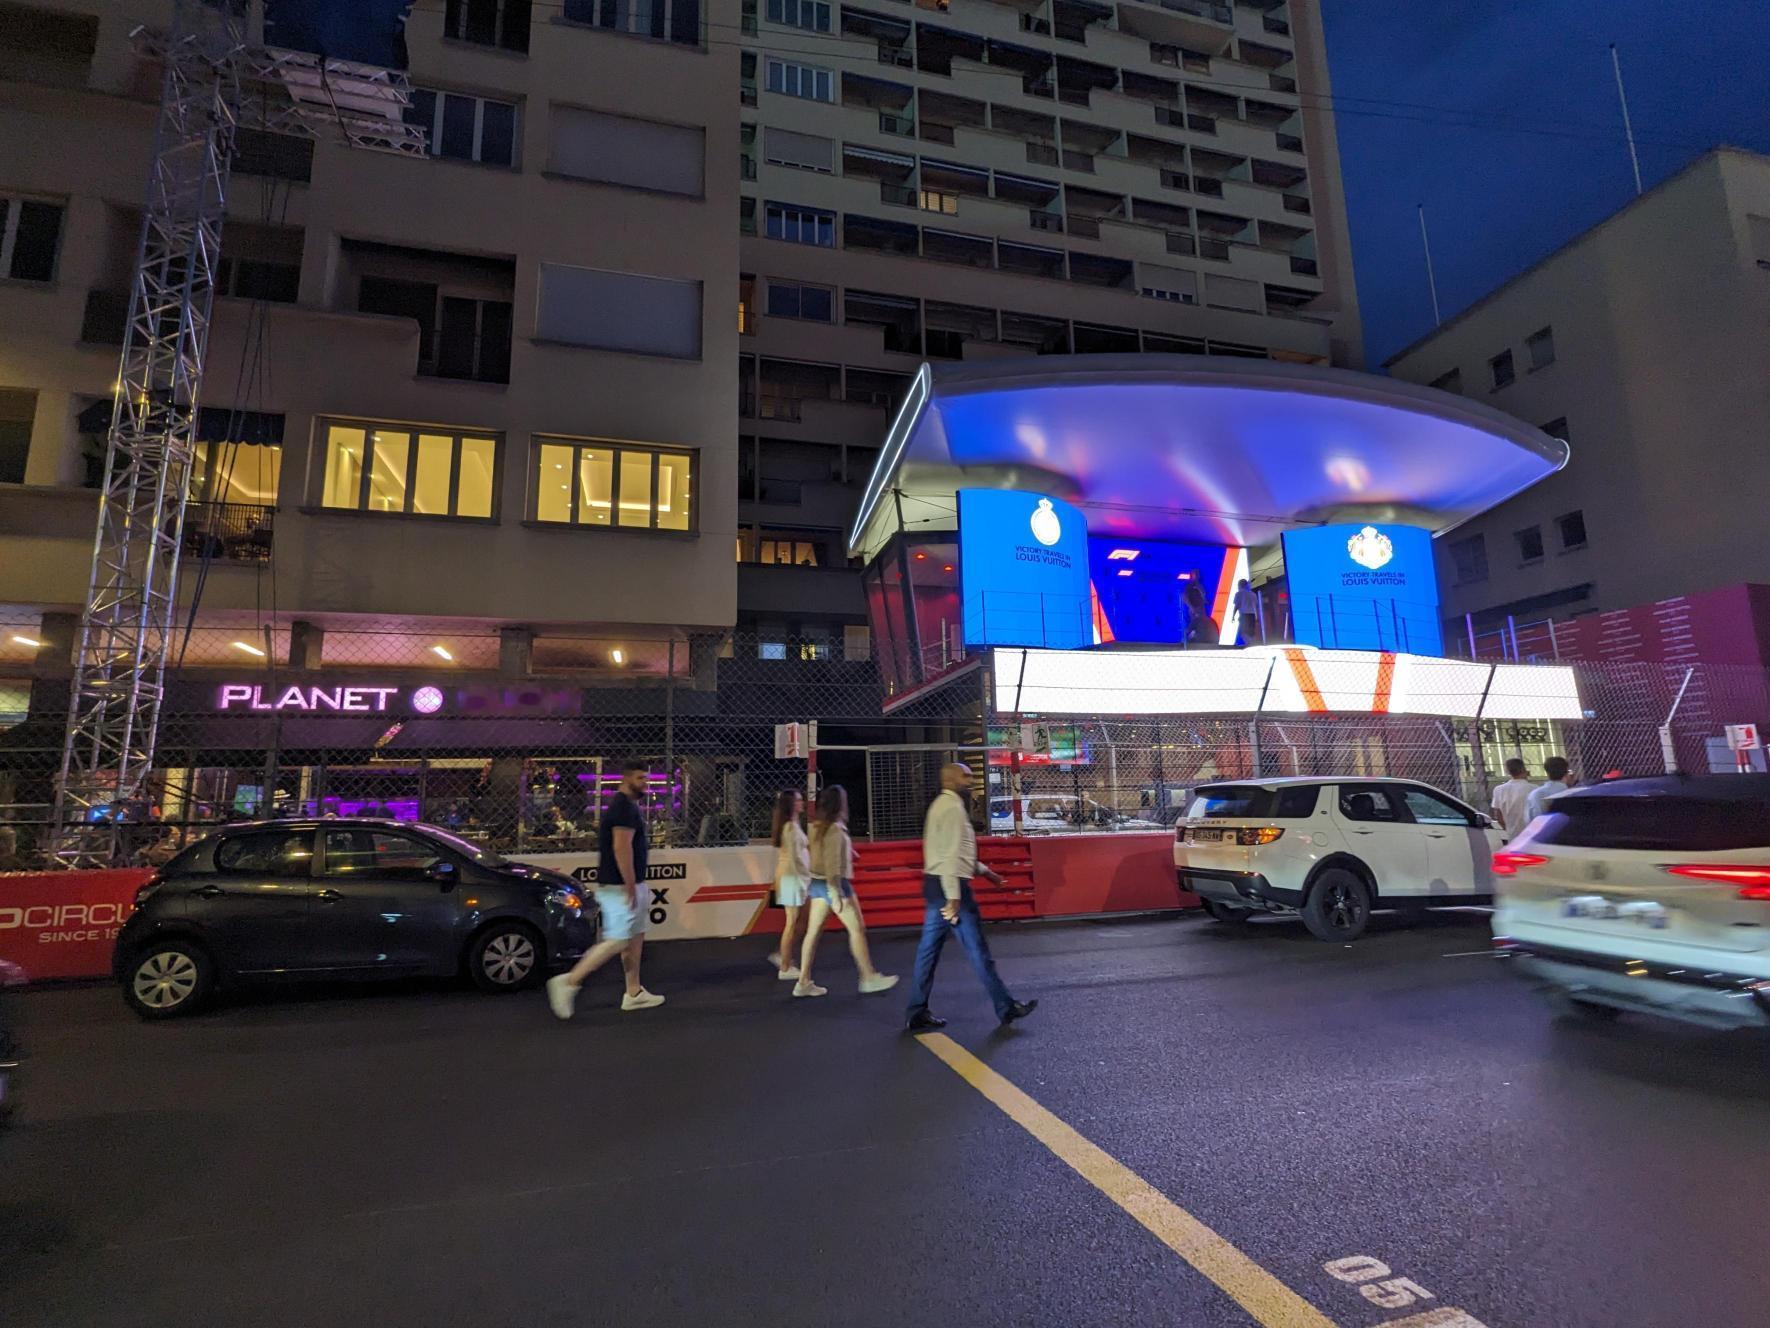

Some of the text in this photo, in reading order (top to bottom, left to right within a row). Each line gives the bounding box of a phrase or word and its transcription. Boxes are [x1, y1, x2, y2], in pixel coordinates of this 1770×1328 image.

[1015, 546, 1042, 555] VICTORY
[1015, 552, 1071, 568] LOUIS VUITTON
[1342, 577, 1406, 586] LOUIS VUITTON
[220, 685, 398, 711] PLANET
[645, 865, 684, 878] ITTON
[39, 930, 99, 943] SINCE
[1322, 1255, 1436, 1309] 05
